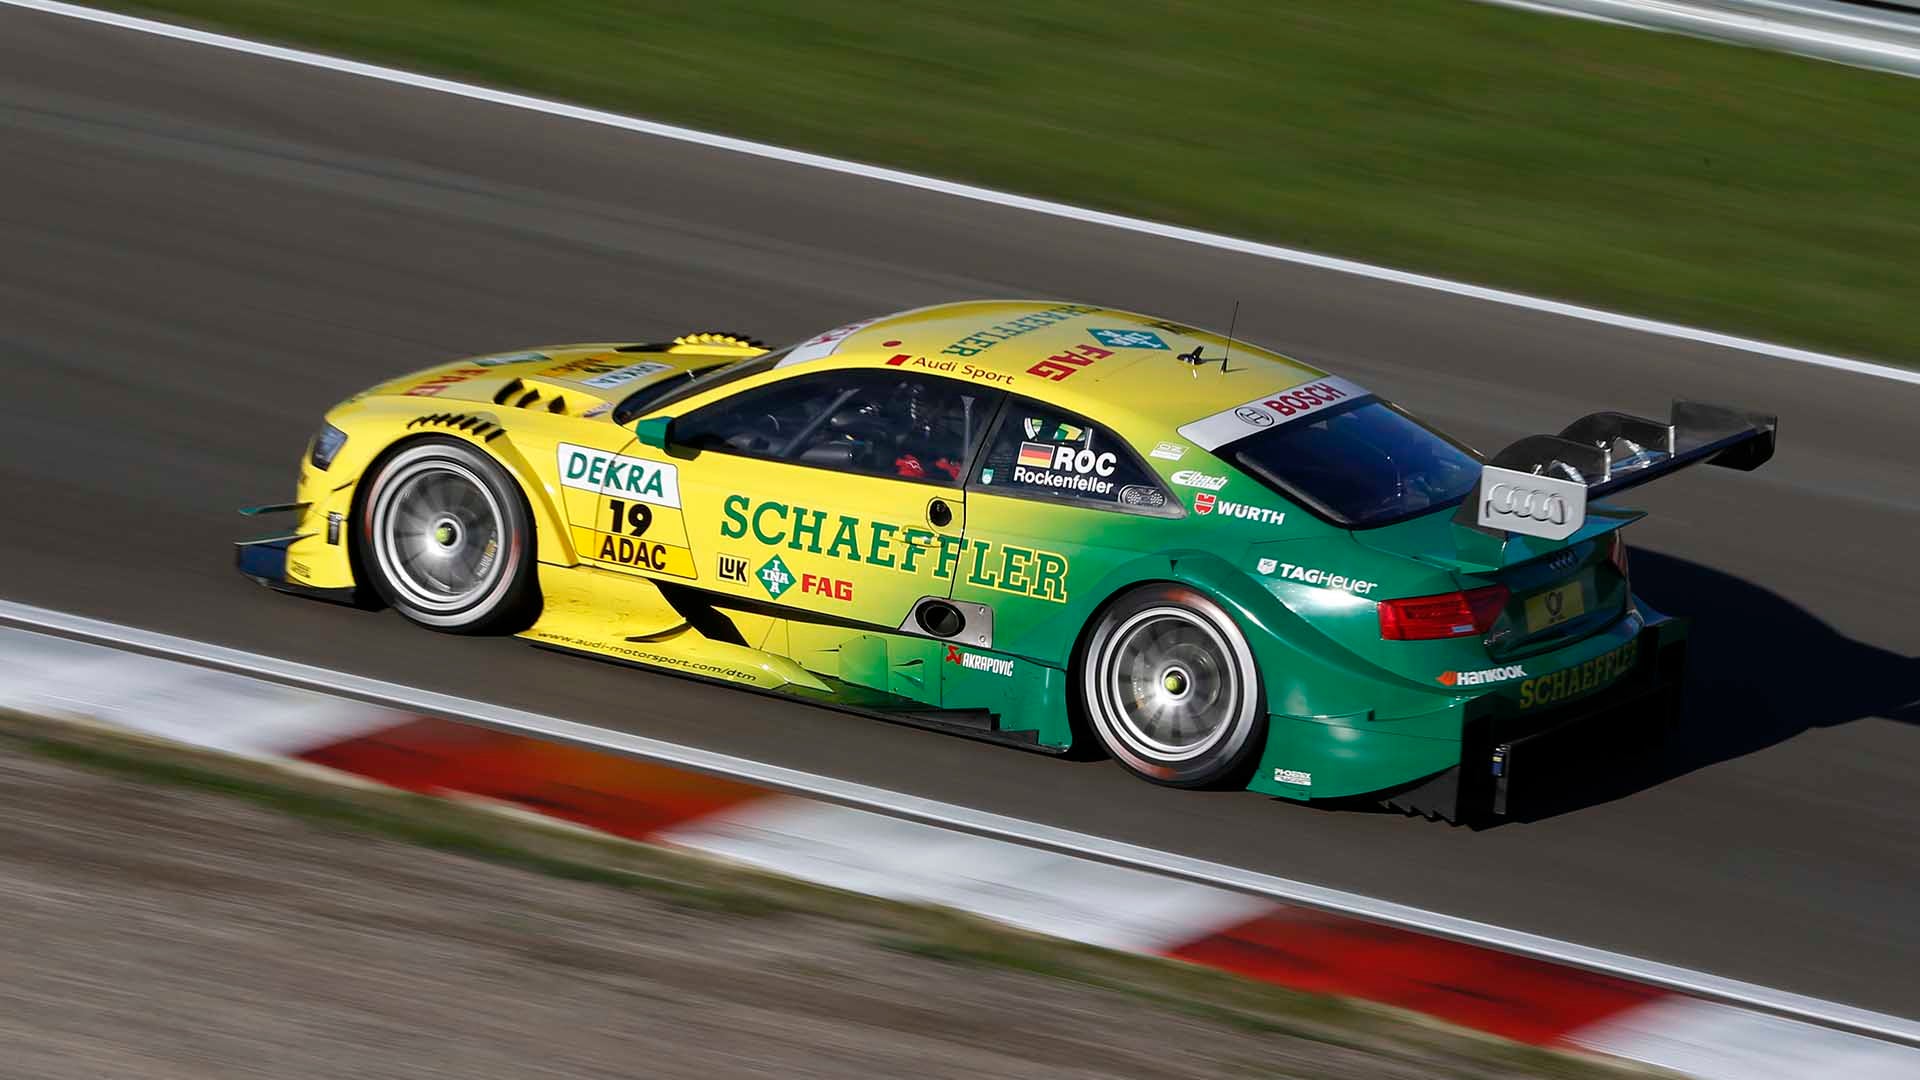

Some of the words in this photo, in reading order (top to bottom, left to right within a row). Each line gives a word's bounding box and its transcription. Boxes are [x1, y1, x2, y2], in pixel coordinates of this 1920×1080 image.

[940, 304, 1103, 357] HAEFFLER
[912, 356, 957, 372] Audi
[961, 364, 1015, 385] Sport
[1025, 344, 1115, 382] FAG
[1264, 382, 1348, 417] BOSCH
[566, 451, 664, 498] DEKRA
[1053, 446, 1117, 477] ROC
[1013, 466, 1114, 495] Rockenfeller
[609, 499, 653, 537] 19
[1218, 500, 1286, 526] WÜRTH
[599, 535, 666, 571] ADAC
[720, 494, 1069, 603] SCHAEFFLER
[801, 573, 853, 601] FAG
[537, 631, 757, 682] www.audi-motorsport.com/dtm
